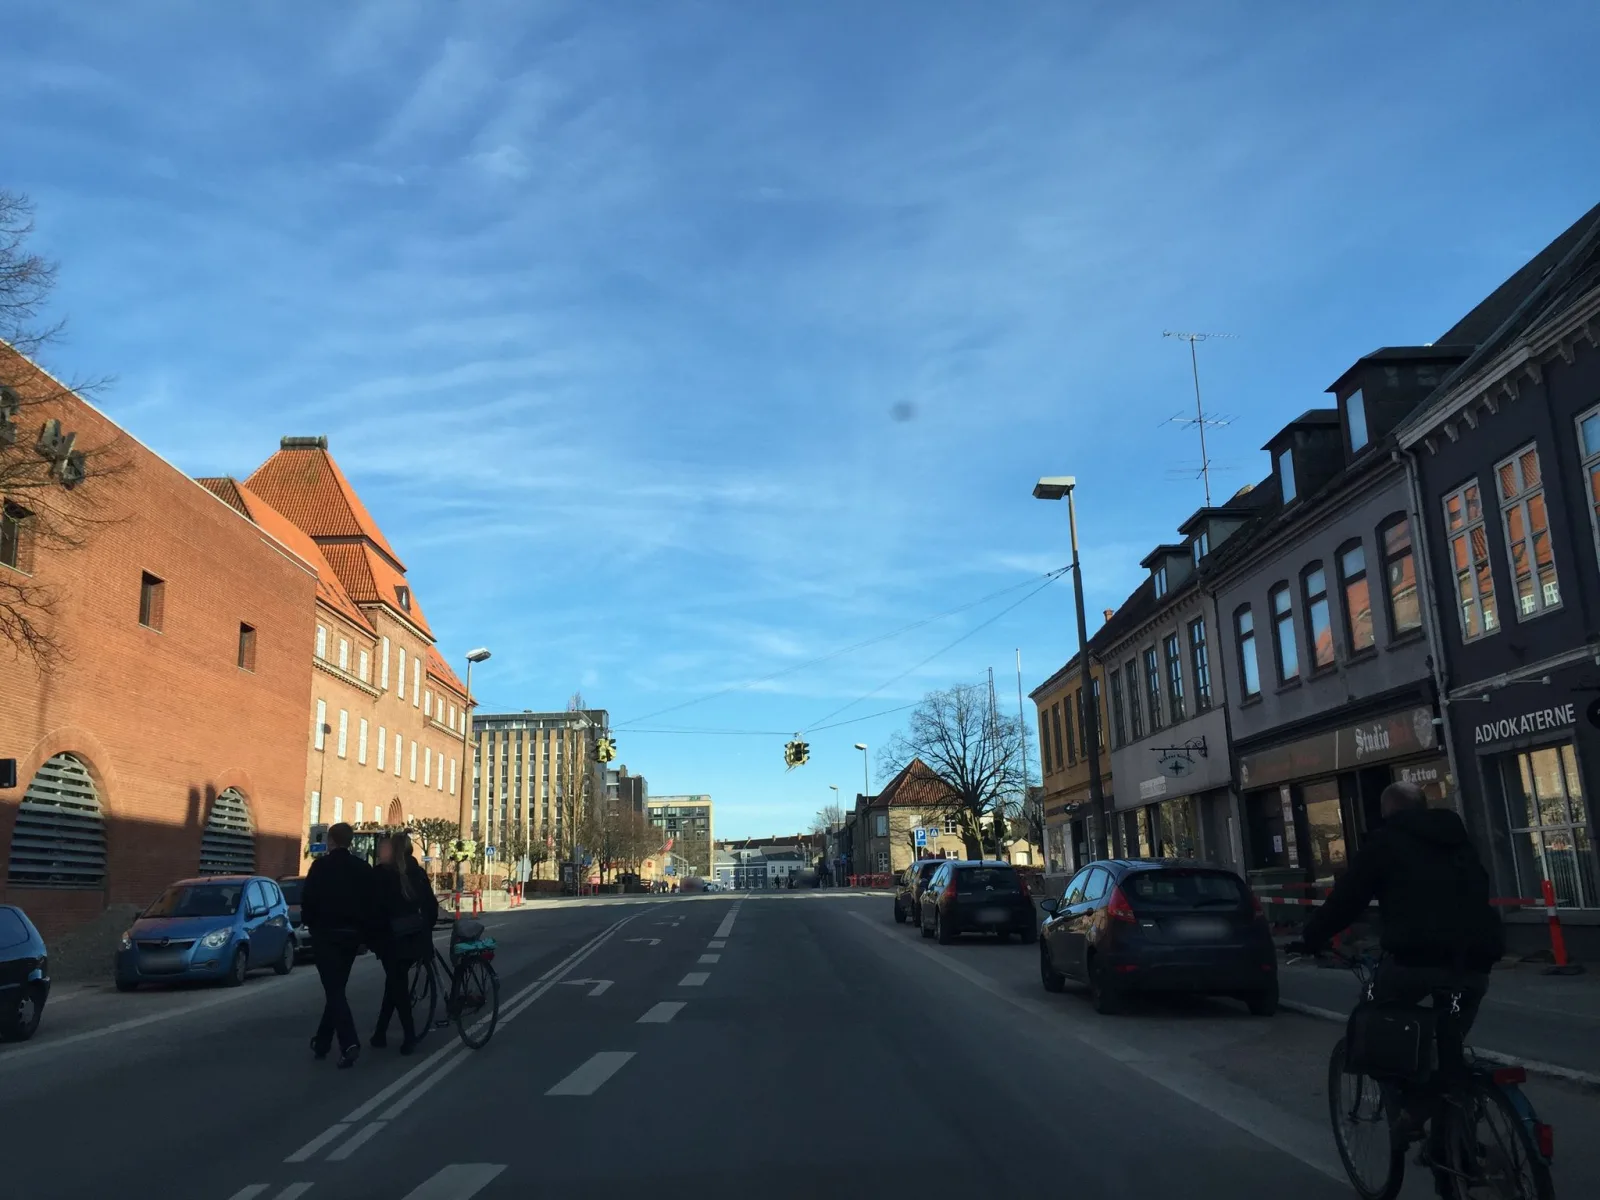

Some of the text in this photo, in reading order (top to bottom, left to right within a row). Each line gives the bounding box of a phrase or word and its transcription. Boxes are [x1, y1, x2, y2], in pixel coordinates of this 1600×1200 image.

[1355, 723, 1390, 760] Studio
[1475, 703, 1576, 744] ADVOKATERNE
[1401, 768, 1437, 783] Tattoo
